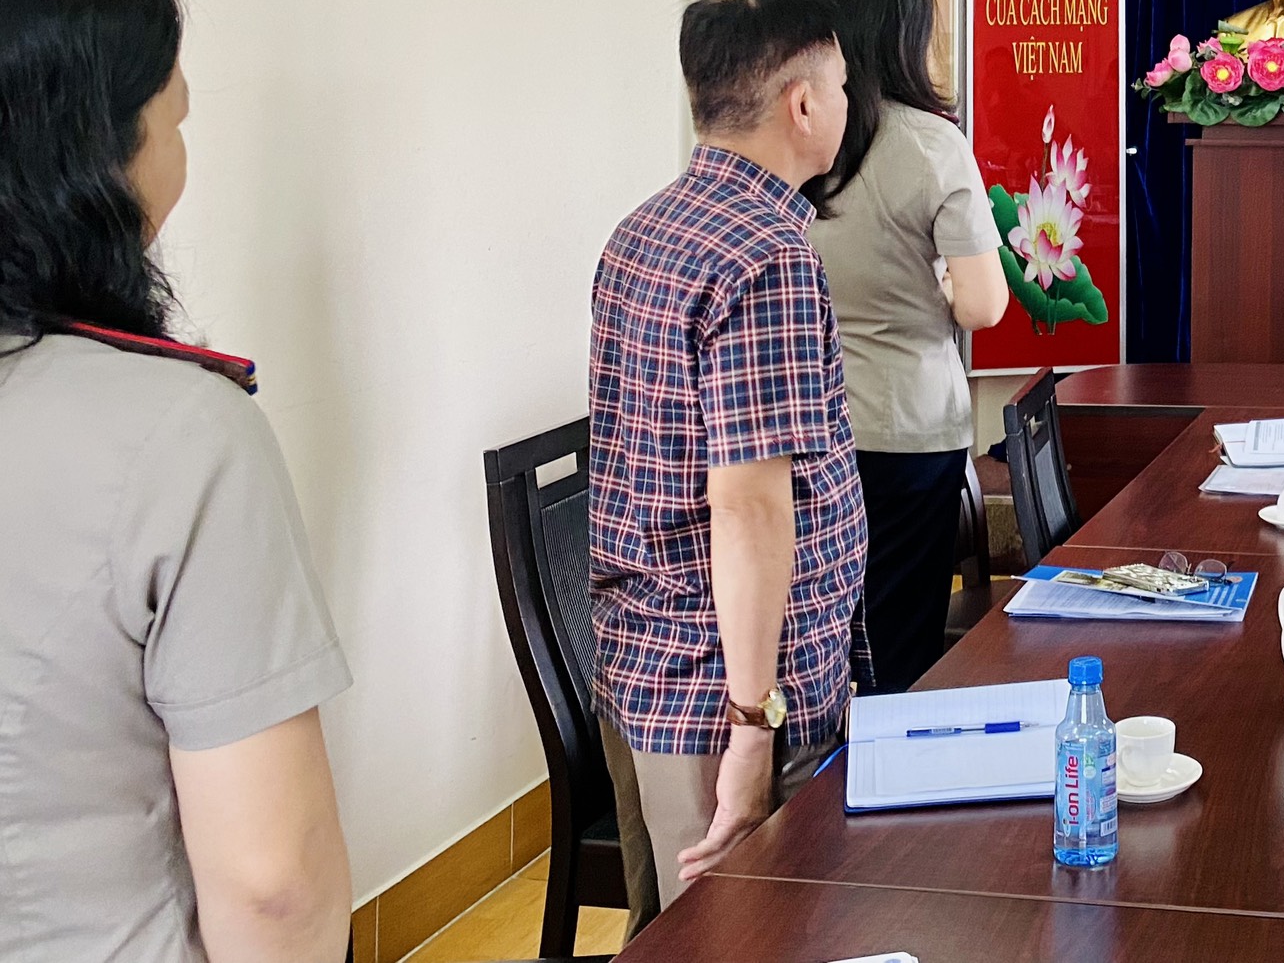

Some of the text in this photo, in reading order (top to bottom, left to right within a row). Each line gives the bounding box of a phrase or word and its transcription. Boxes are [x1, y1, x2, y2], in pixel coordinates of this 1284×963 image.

[1012, 36, 1083, 81] VIỆT NAM
[1064, 755, 1079, 789] Life
